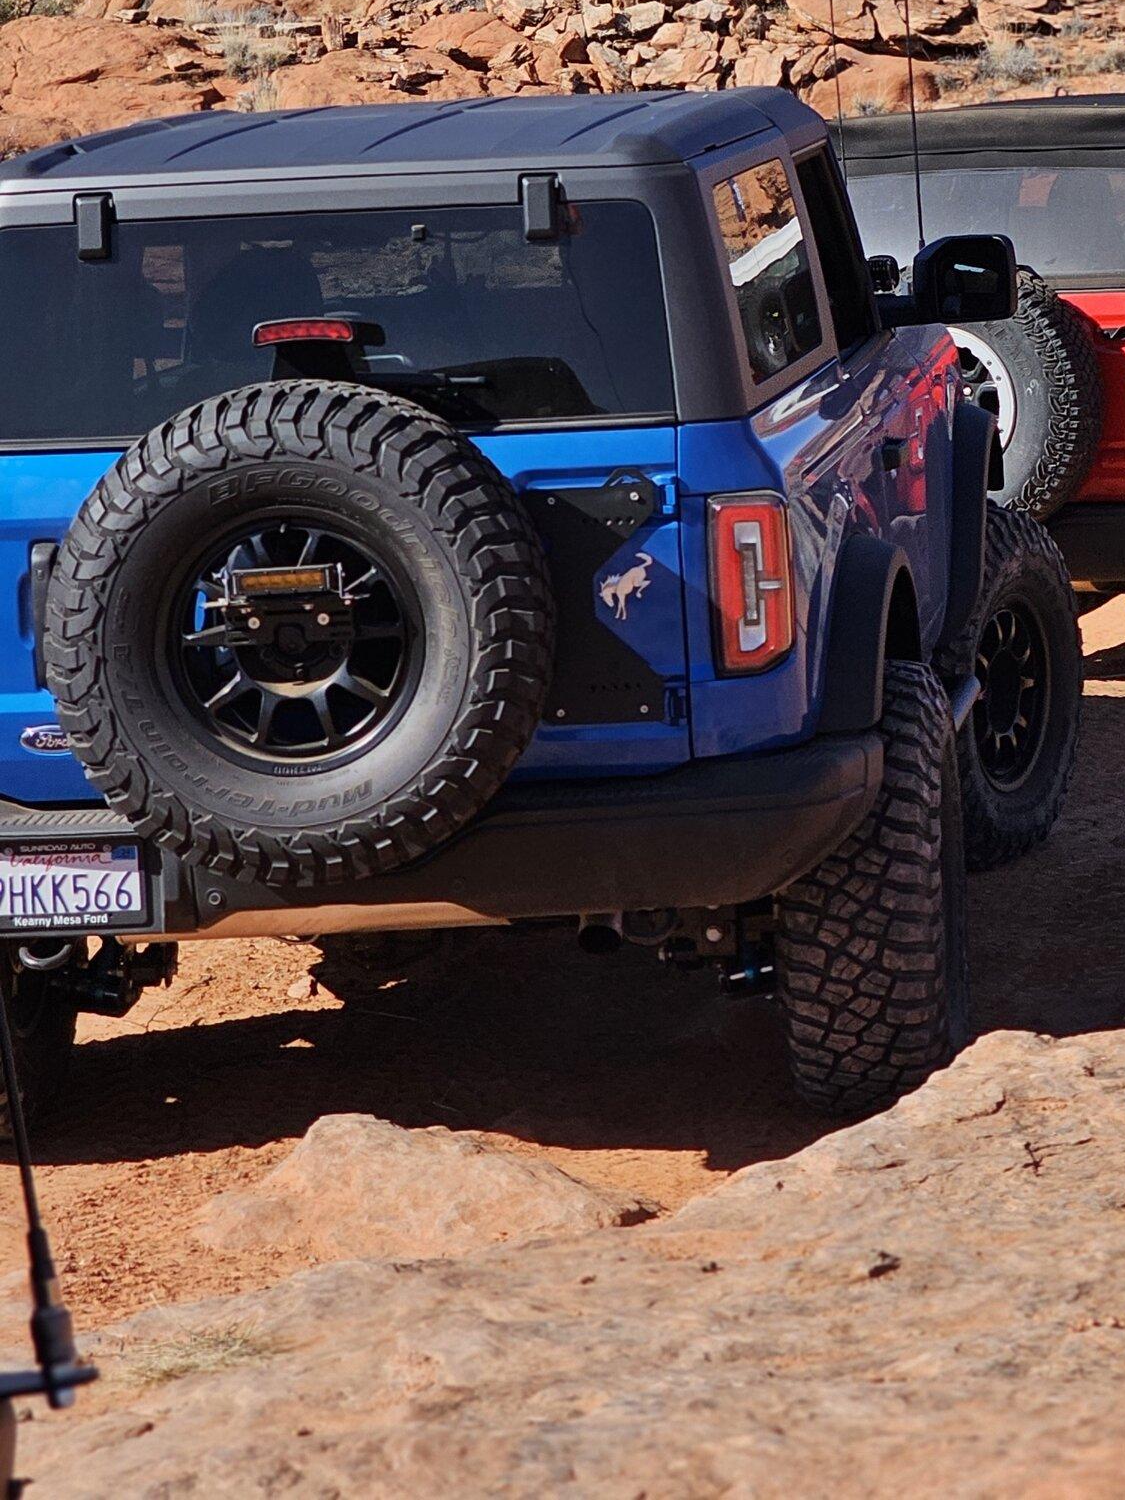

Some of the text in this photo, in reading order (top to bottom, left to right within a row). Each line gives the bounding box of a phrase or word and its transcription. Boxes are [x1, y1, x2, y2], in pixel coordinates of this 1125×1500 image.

[20, 843, 96, 853] SUNROAD AUTO
[10, 853, 112, 872] California
[14, 913, 108, 927] Kearny Mesa Ford
